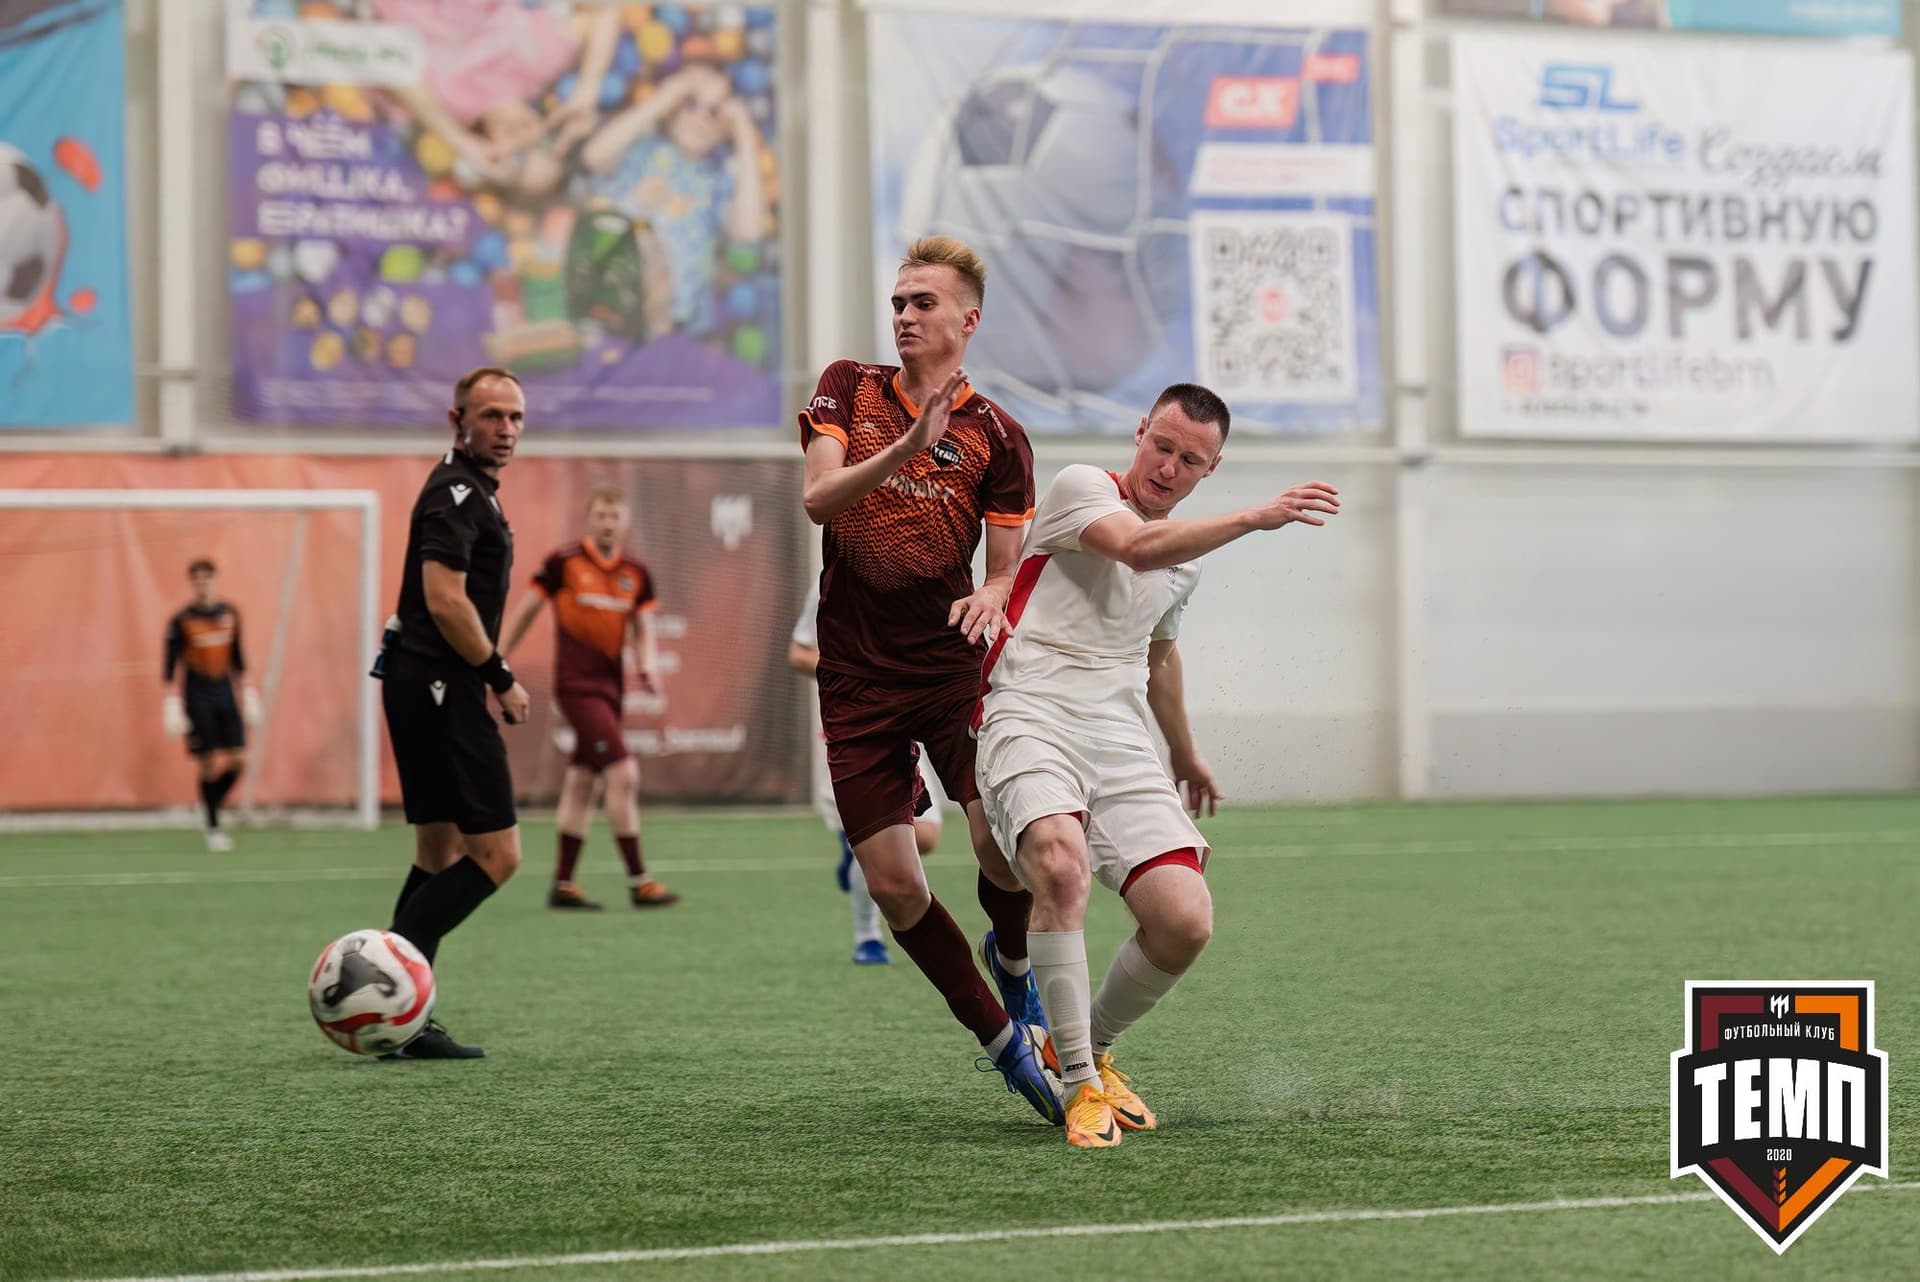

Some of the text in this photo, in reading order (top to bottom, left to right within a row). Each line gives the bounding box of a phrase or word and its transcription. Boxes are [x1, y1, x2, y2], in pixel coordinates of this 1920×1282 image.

[1538, 63, 1641, 112] SL
[1499, 185, 1879, 243] СПОРТИВНУЮ
[1501, 248, 1875, 344] ФОРМУ
